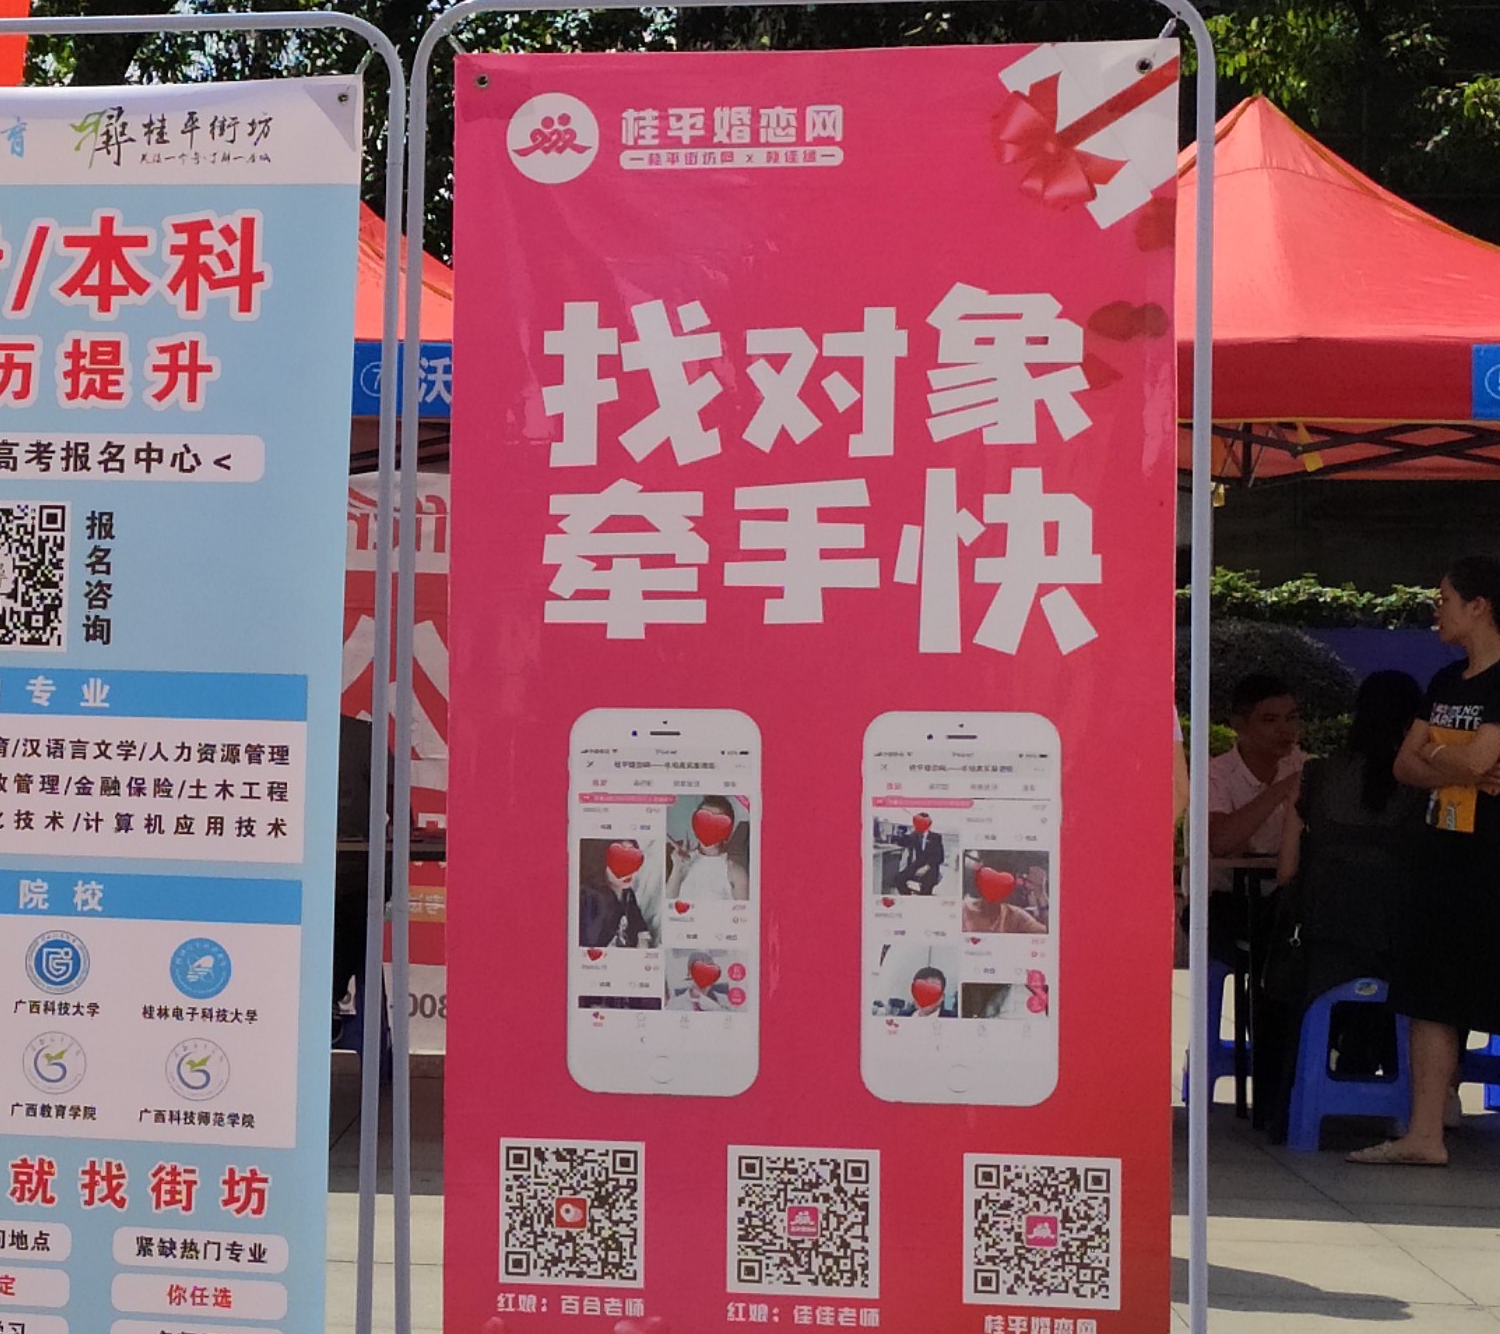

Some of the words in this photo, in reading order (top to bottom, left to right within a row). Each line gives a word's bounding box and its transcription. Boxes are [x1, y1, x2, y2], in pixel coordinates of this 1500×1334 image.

[620, 104, 844, 146] 桂平婚恋网
[541, 281, 1093, 468] 找对象
[542, 466, 1103, 656] 牵手快
[83, 510, 116, 647] 报名咨询
[13, 998, 101, 1017] 广西科技大学
[141, 1004, 259, 1025] 桂林电子科技大学
[10, 1102, 97, 1121] 广西教育学院
[138, 1108, 256, 1129] 广西科技师范学院
[134, 1235, 268, 1266] 紧缺热门专业
[166, 1283, 234, 1310] 你任选
